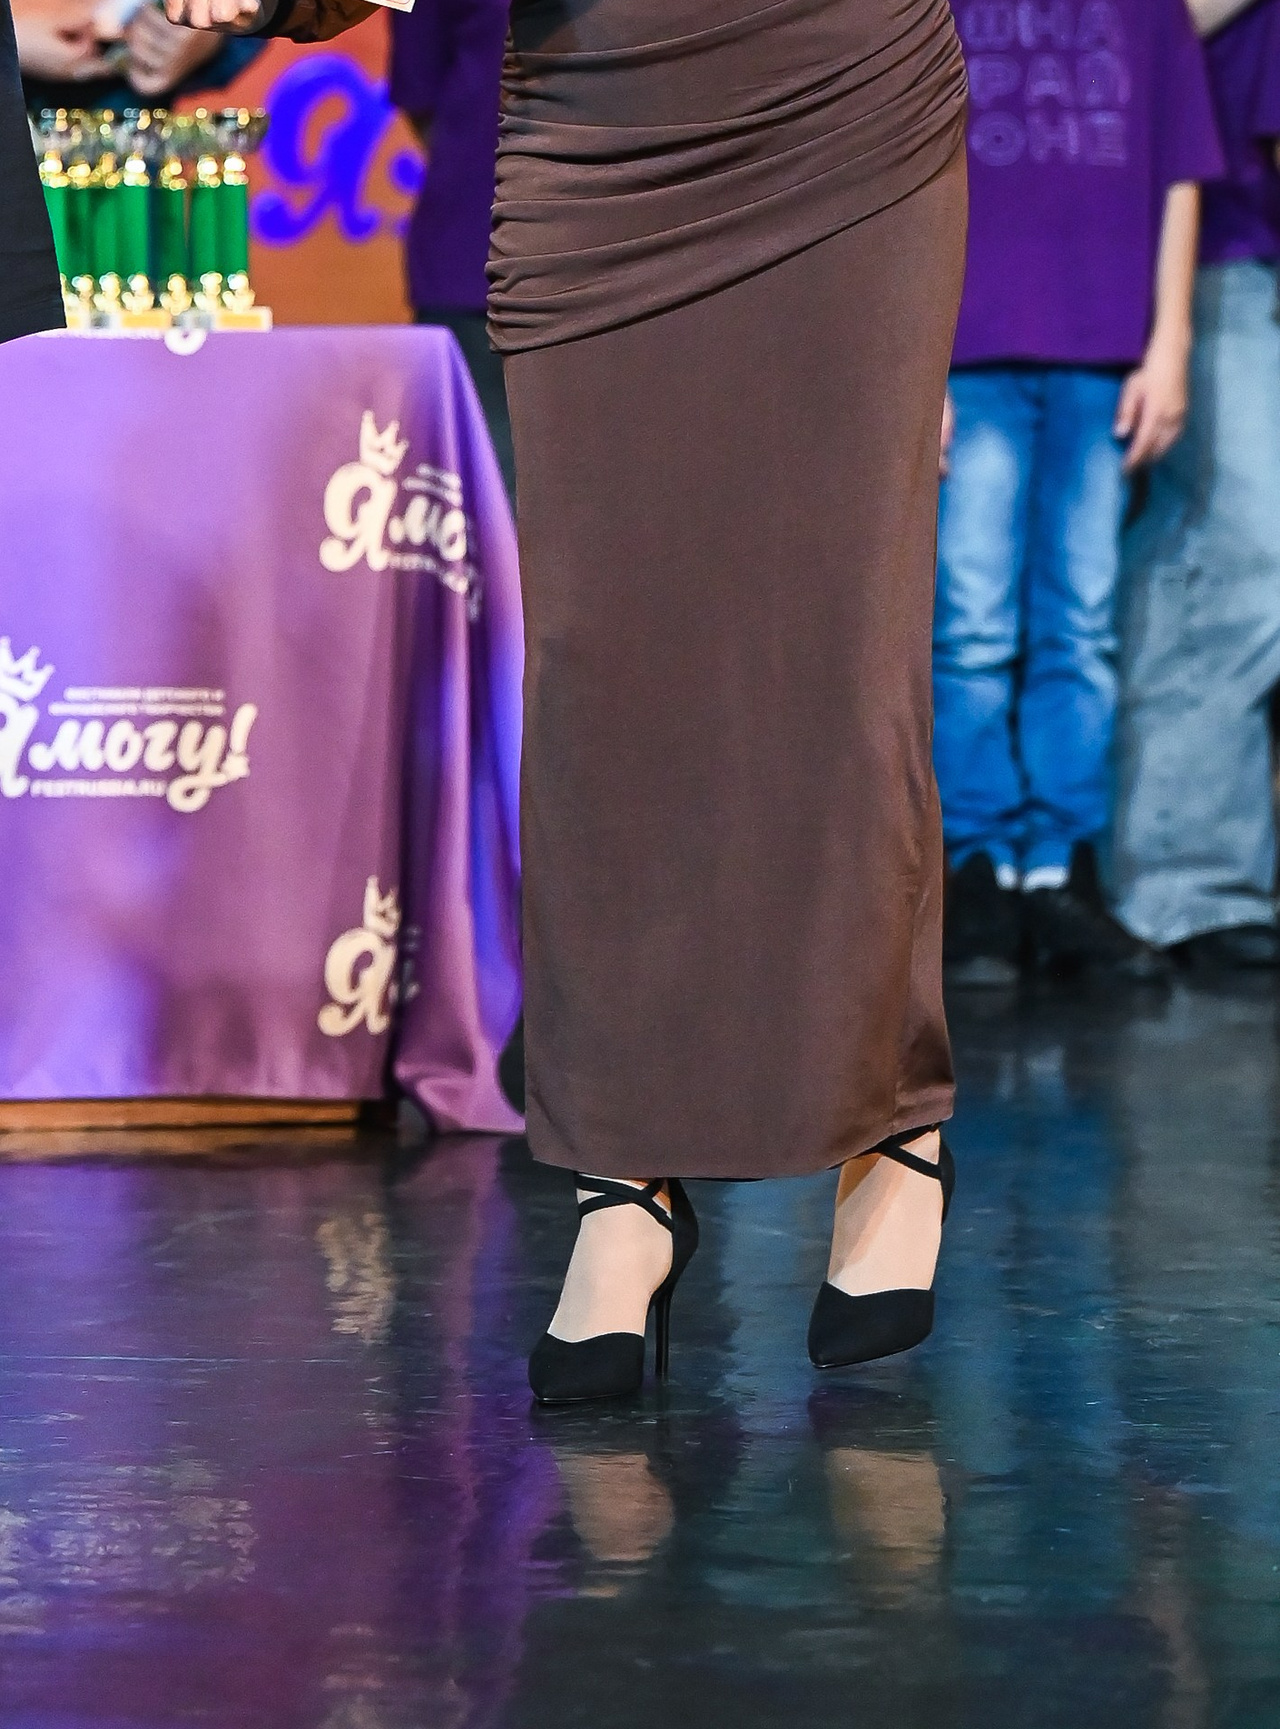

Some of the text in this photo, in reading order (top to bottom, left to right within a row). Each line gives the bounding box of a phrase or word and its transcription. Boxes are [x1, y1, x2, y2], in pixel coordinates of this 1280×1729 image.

[320, 461, 398, 572] Я
[27, 703, 258, 814] могу!
[318, 927, 398, 1038] Я
